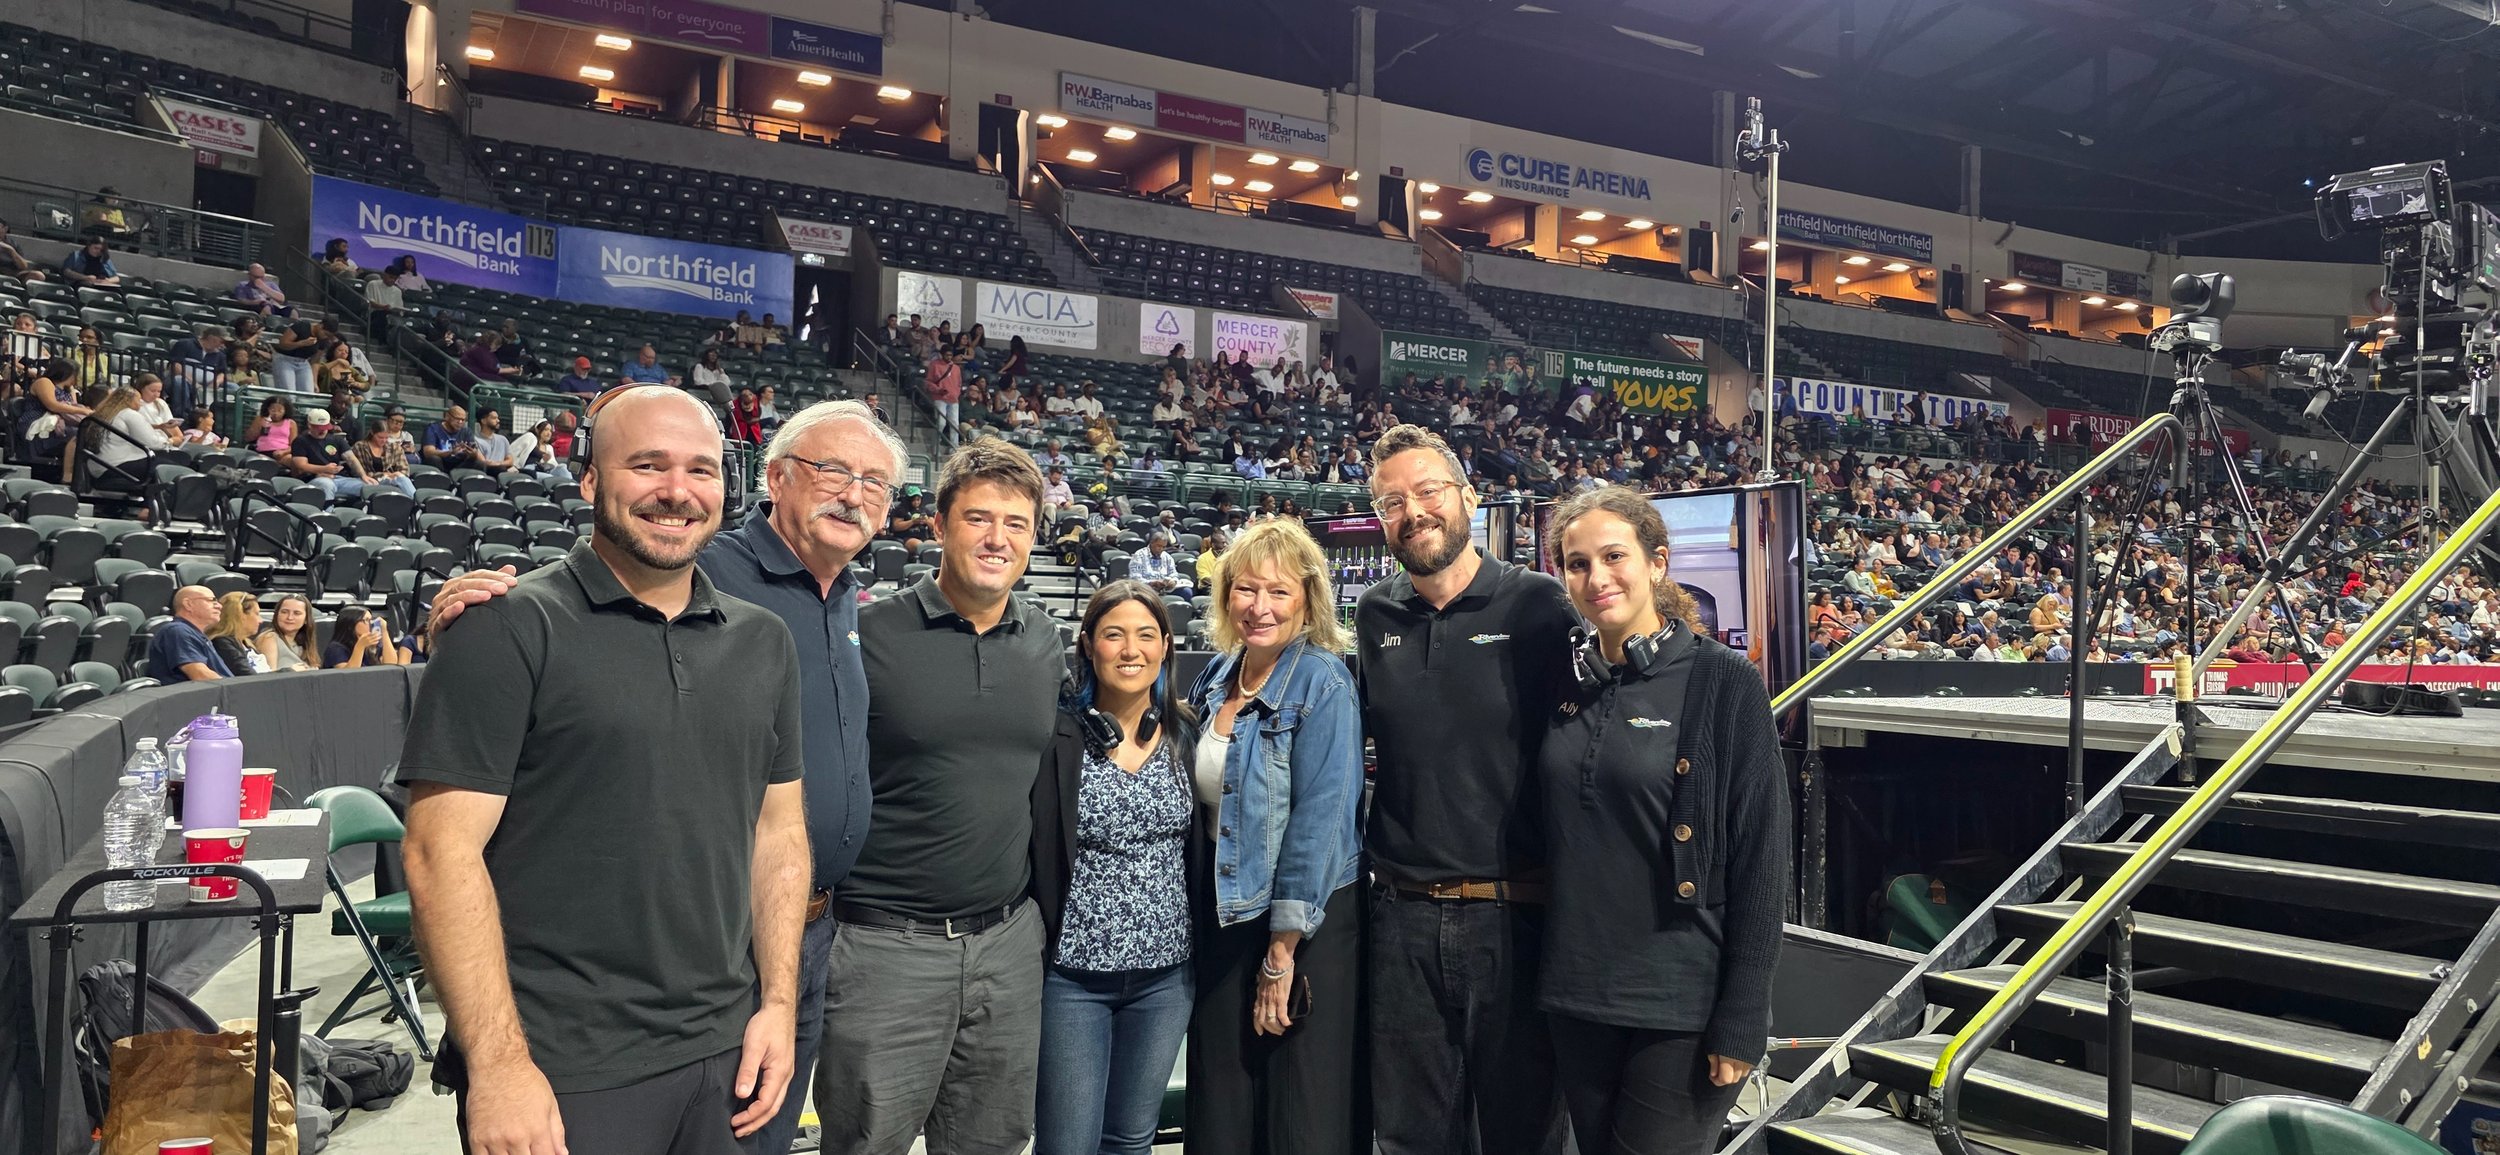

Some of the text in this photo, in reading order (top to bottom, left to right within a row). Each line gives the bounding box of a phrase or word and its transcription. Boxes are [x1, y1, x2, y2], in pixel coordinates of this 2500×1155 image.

[614, 0, 645, 16] plan
[652, 5, 673, 20] for
[676, 11, 746, 35] everyone.
[787, 40, 865, 63] AmeriHealth
[1065, 82, 1153, 111] RWJBarnabas
[1076, 97, 1113, 112] HEALTH
[172, 109, 246, 136] CASE'S
[1159, 106, 1175, 116] Let's
[1176, 108, 1186, 117] be
[1186, 111, 1211, 124] healthy
[1248, 117, 1327, 143] RWJBarnabas
[1258, 132, 1291, 145] HEALTH
[198, 150, 217, 165] EXIT
[1500, 153, 1651, 201] CURE ARENA
[1500, 177, 1570, 199] INSURANCE
[358, 201, 522, 258] Northfield
[788, 224, 843, 241] CASE'S
[1822, 219, 1878, 242] Northfield
[1878, 230, 1932, 251] Northfield
[527, 224, 555, 258] 113
[1804, 230, 1931, 259] Bank Bank Bank
[478, 253, 521, 276] Bank
[600, 245, 756, 289] Northfield
[714, 286, 754, 305] Bank
[991, 287, 1079, 324] MCIA
[990, 322, 1078, 339] MERCER COUNTY
[1217, 319, 1279, 339] MERCER
[1216, 335, 1276, 355] COUNTY
[1407, 342, 1468, 362] MERCER
[1546, 352, 1563, 376] 115
[1573, 357, 1703, 385] The future needs a story
[1572, 373, 1584, 385] to
[1612, 378, 1698, 412] YOURS.
[1882, 390, 1895, 412] 116
[2089, 416, 2132, 436] RIDER
[1380, 632, 1401, 647] Jim
[2205, 671, 2229, 682] THOMAS
[2206, 681, 2226, 692] EDISON
[1558, 701, 1579, 716] Ally
[133, 866, 216, 879] ROCKVILLE
